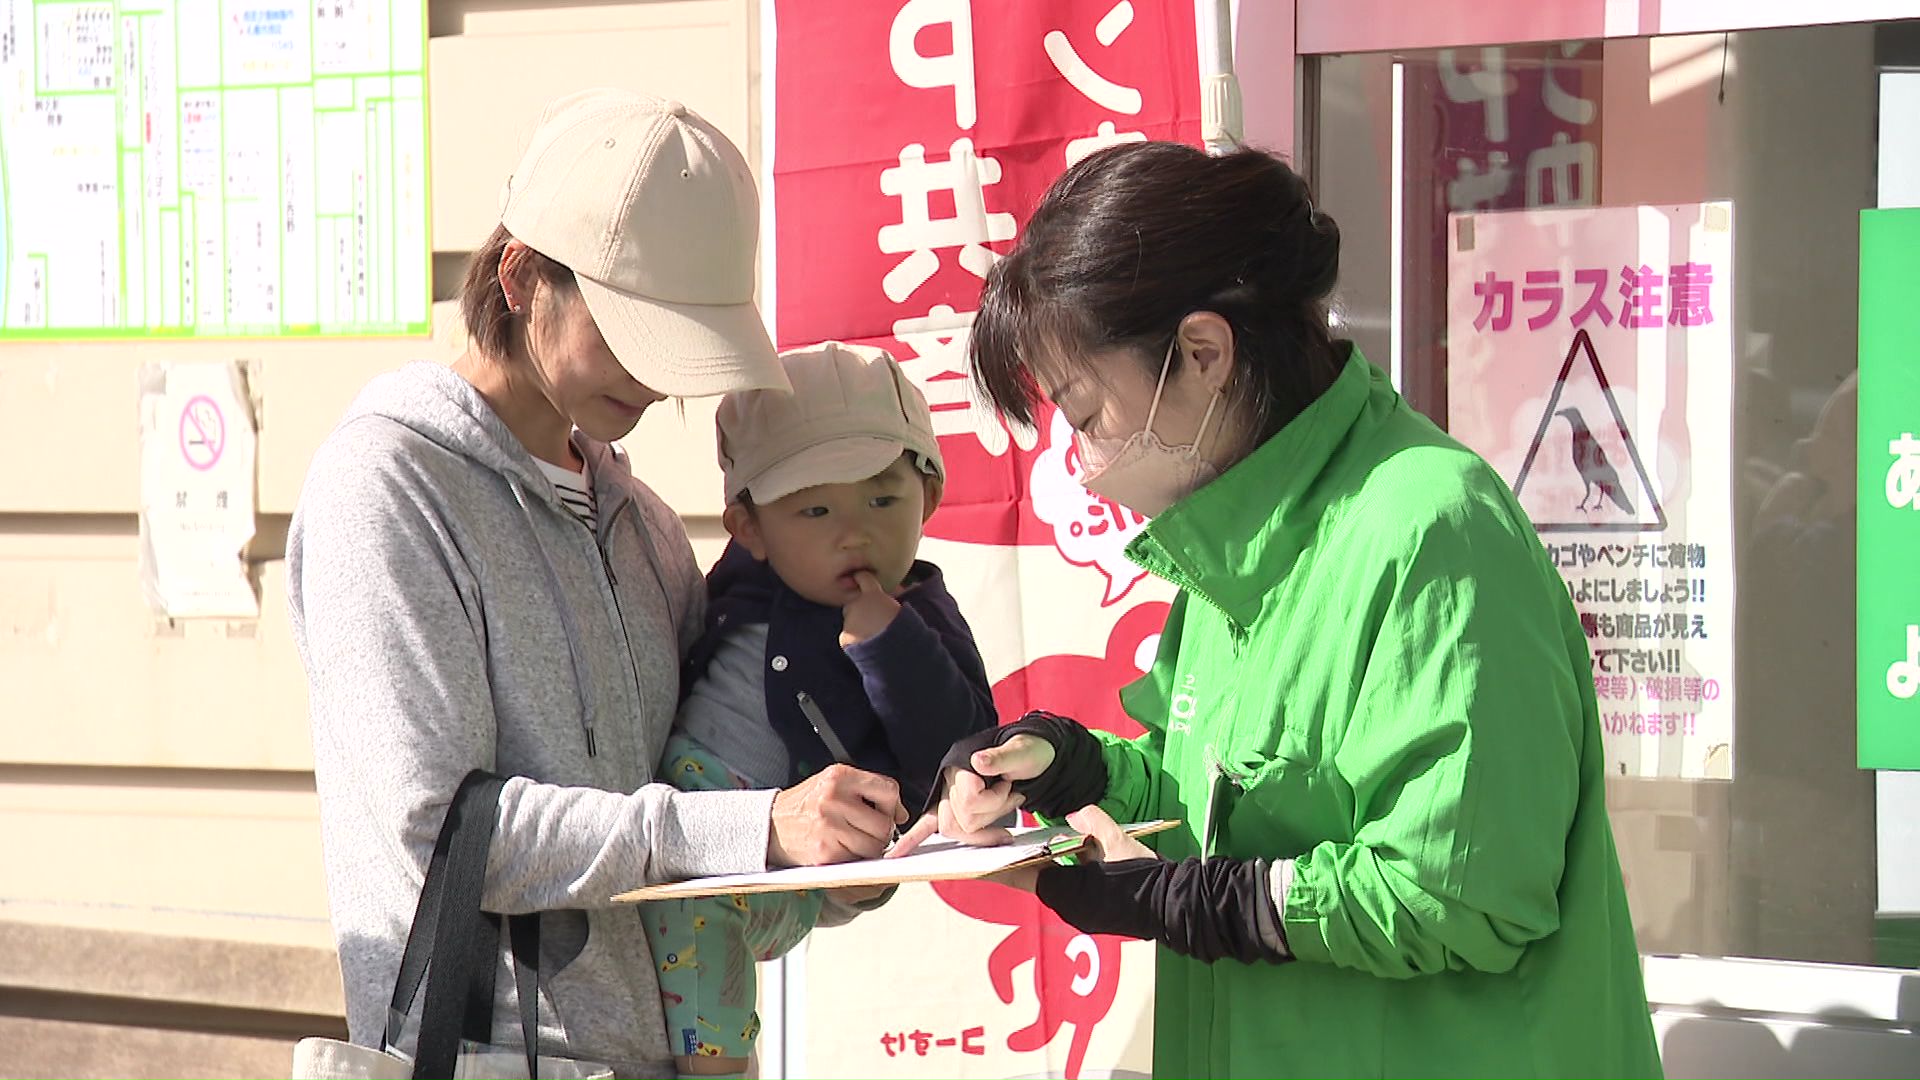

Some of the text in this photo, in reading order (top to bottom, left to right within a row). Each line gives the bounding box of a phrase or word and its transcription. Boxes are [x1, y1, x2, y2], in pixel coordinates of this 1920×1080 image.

[1473, 262, 1714, 332] カラス注意
[1591, 649, 1680, 673] て下さい!!
